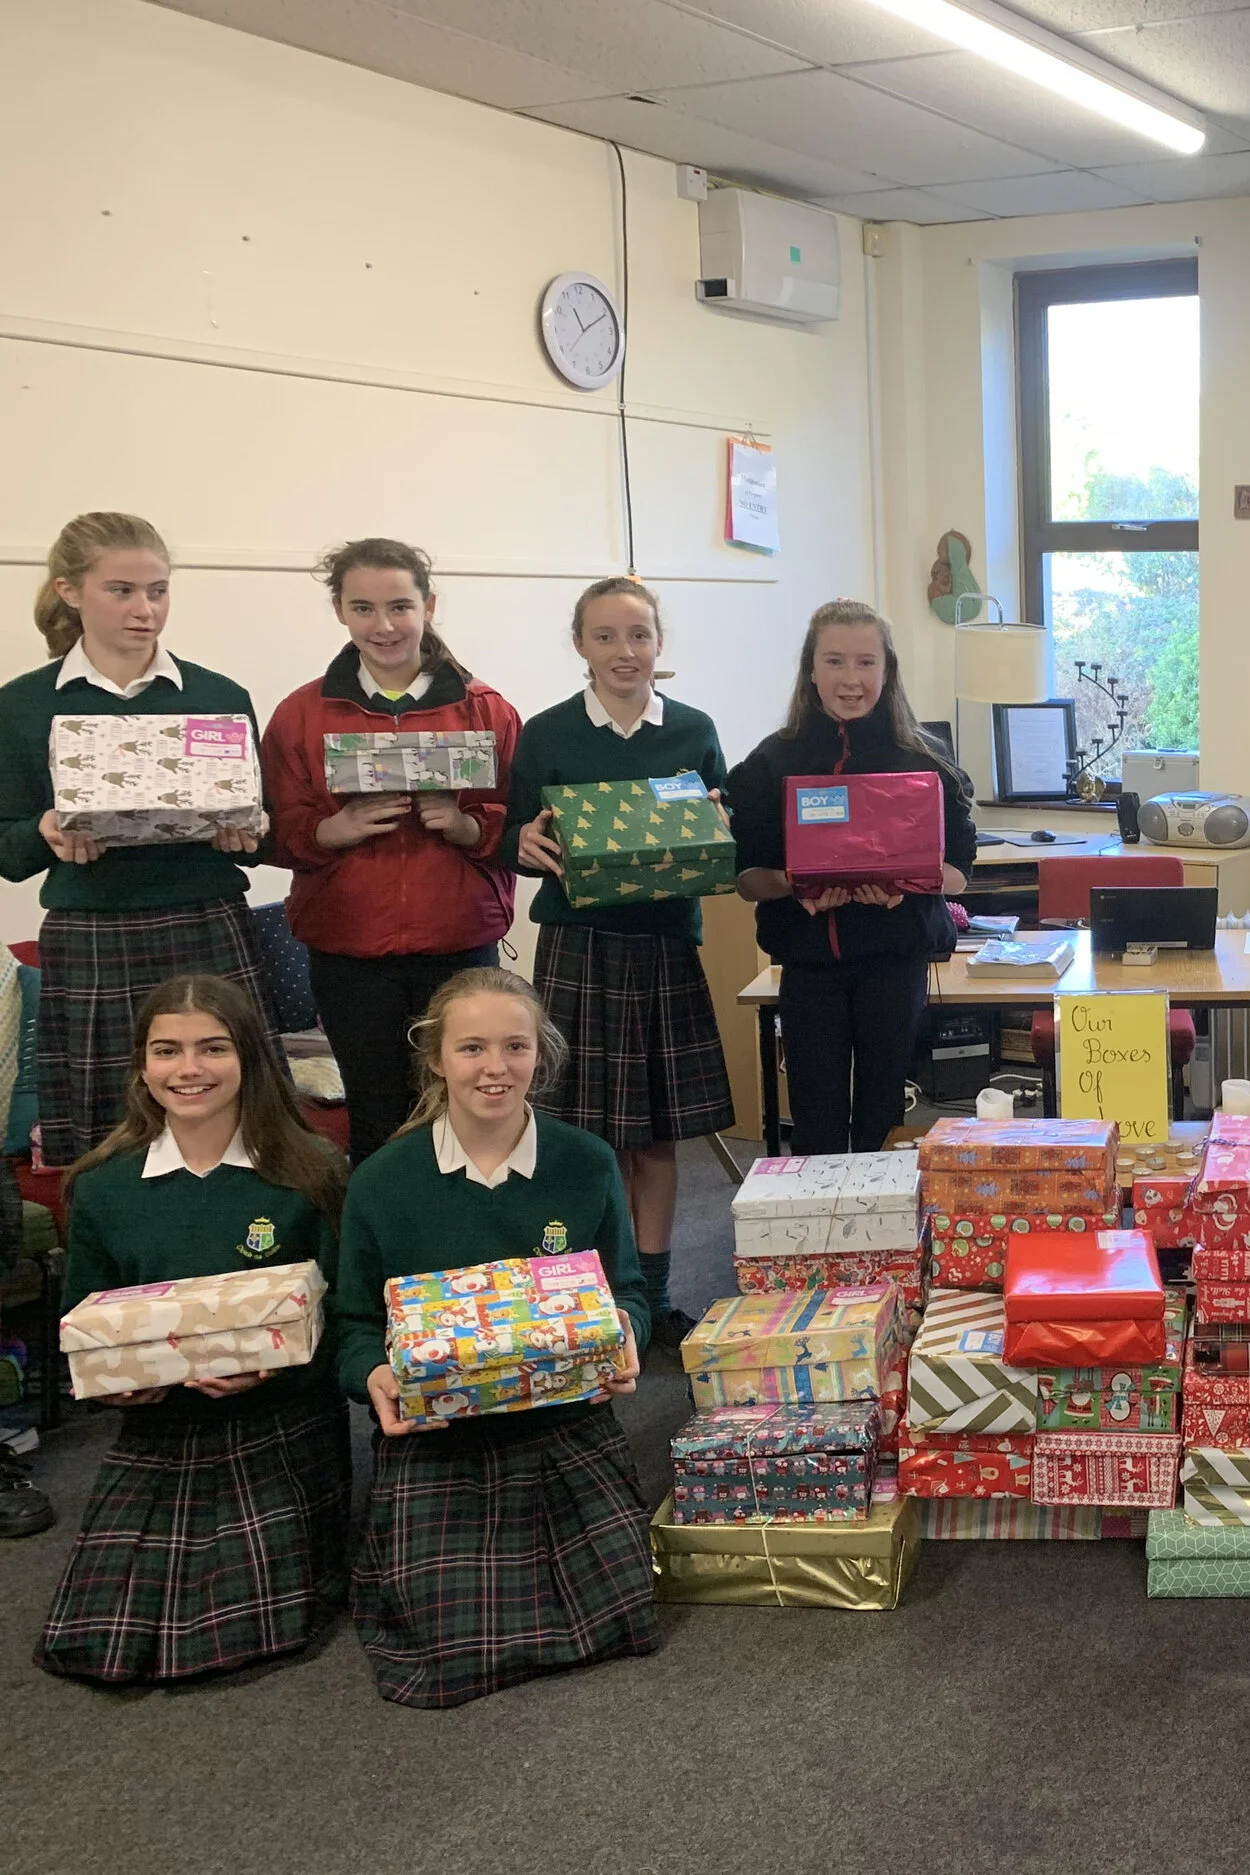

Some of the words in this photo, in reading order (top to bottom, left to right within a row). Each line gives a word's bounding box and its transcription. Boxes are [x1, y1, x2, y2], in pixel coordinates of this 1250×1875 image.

[190, 729, 226, 742] GIRL
[655, 782, 681, 791] BOY
[801, 795, 829, 807] BOY
[643, 836, 675, 851] GIRL
[1071, 1005, 1112, 1032] Our
[1083, 1037, 1151, 1064] Boxes
[1078, 1070, 1103, 1104] Of
[538, 1263, 576, 1276] GIRL
[836, 1290, 868, 1298] GIRL
[1234, 1286, 1245, 1295] the
